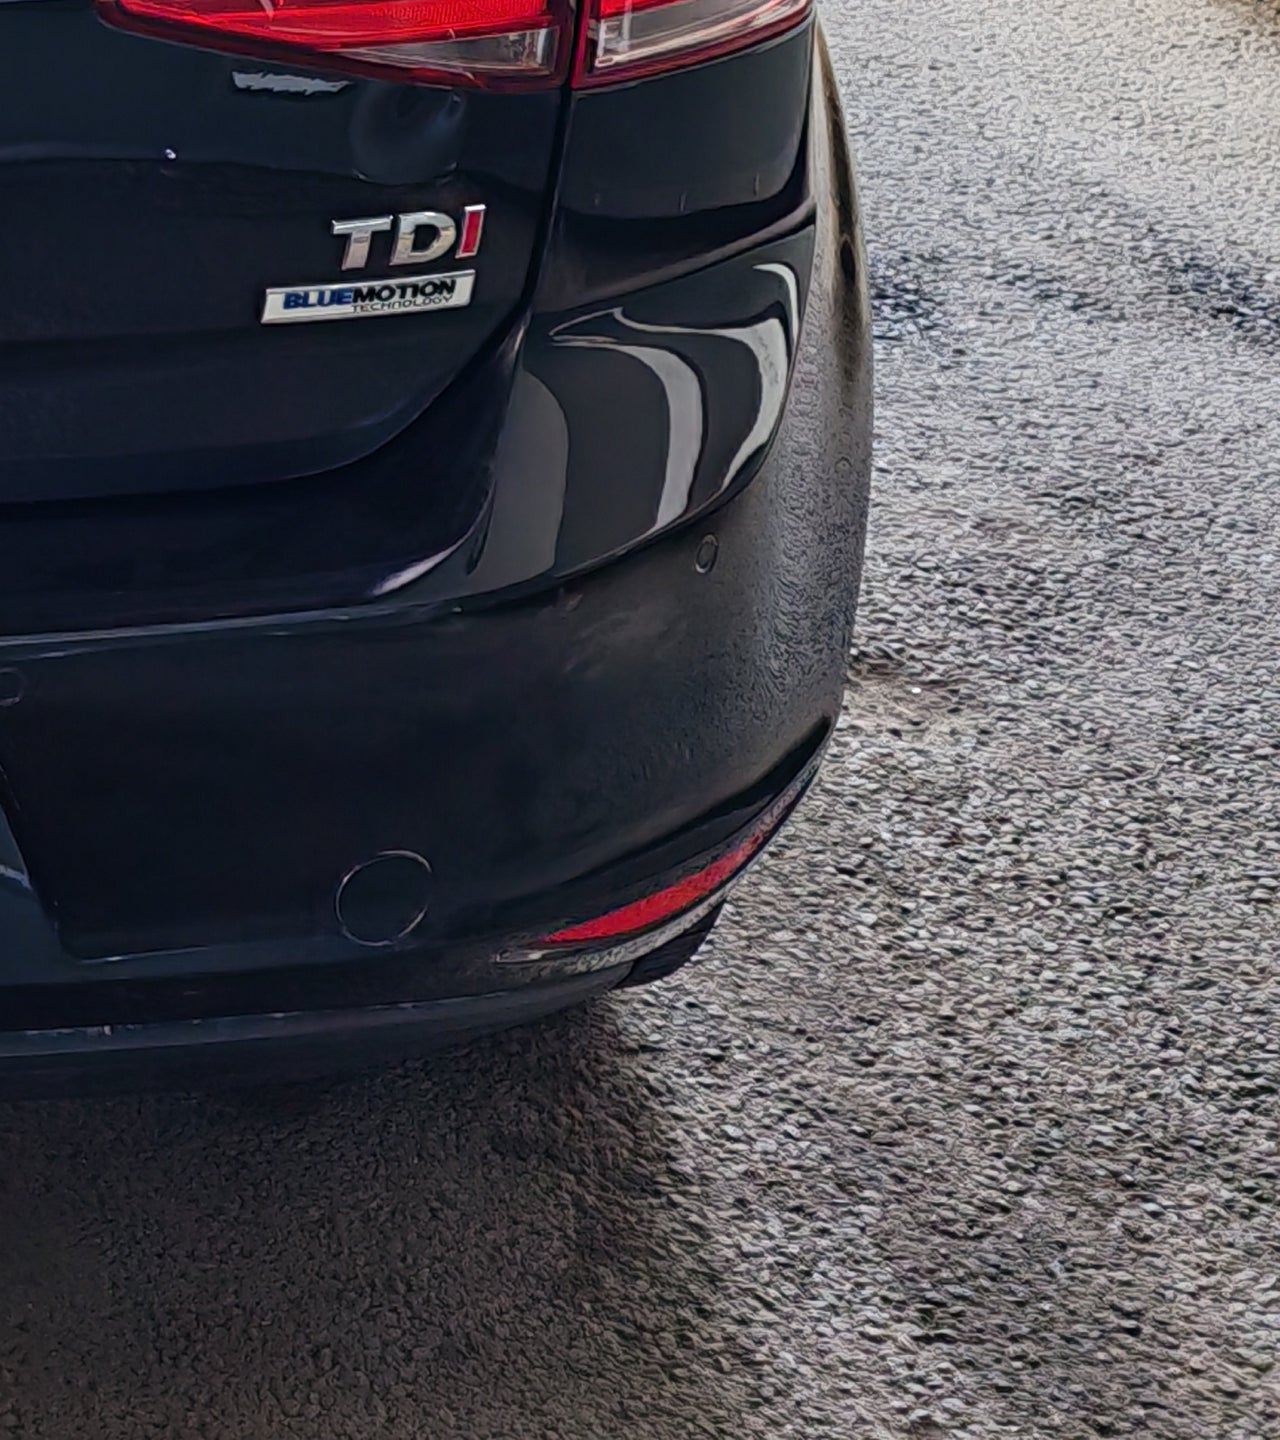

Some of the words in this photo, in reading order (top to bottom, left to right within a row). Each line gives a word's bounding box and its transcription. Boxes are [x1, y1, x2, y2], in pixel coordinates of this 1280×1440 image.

[330, 204, 487, 271] TDI
[283, 278, 457, 310] BLUEMOTION
[351, 296, 454, 314] TECHNOLOGY
